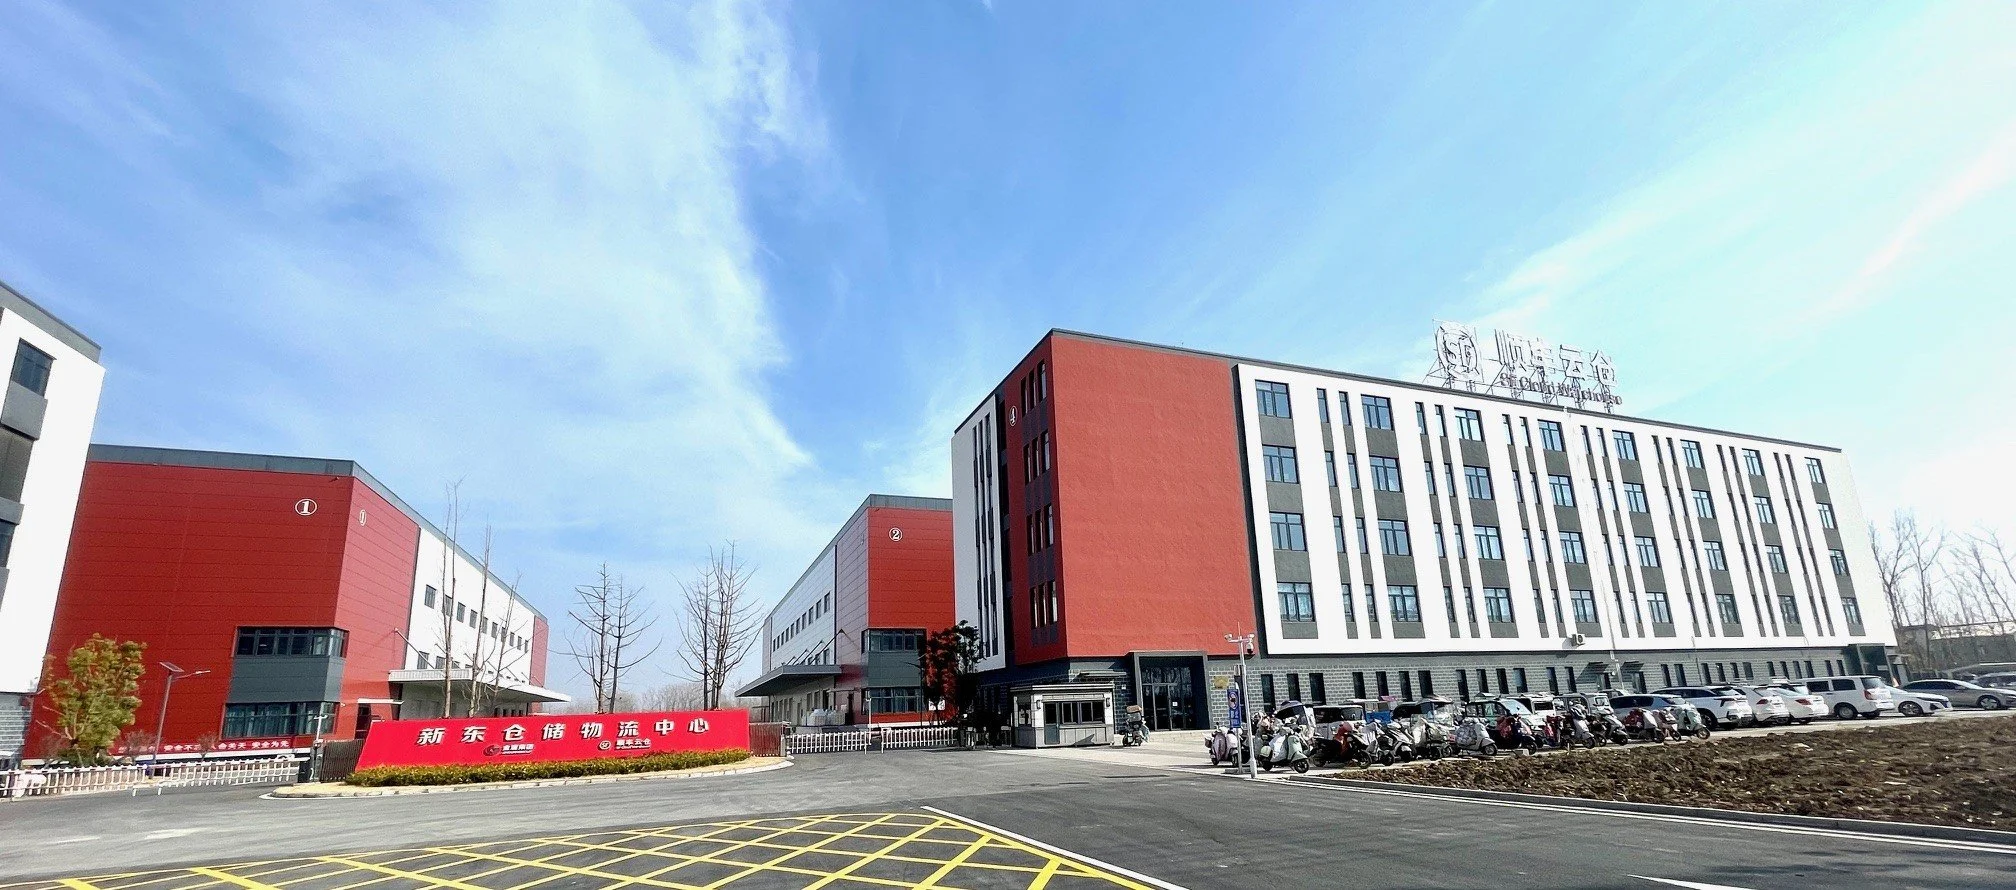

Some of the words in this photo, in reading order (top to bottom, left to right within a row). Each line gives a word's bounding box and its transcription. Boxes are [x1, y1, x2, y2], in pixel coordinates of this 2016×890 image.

[416, 717, 709, 745] 新东仓储物流中心
